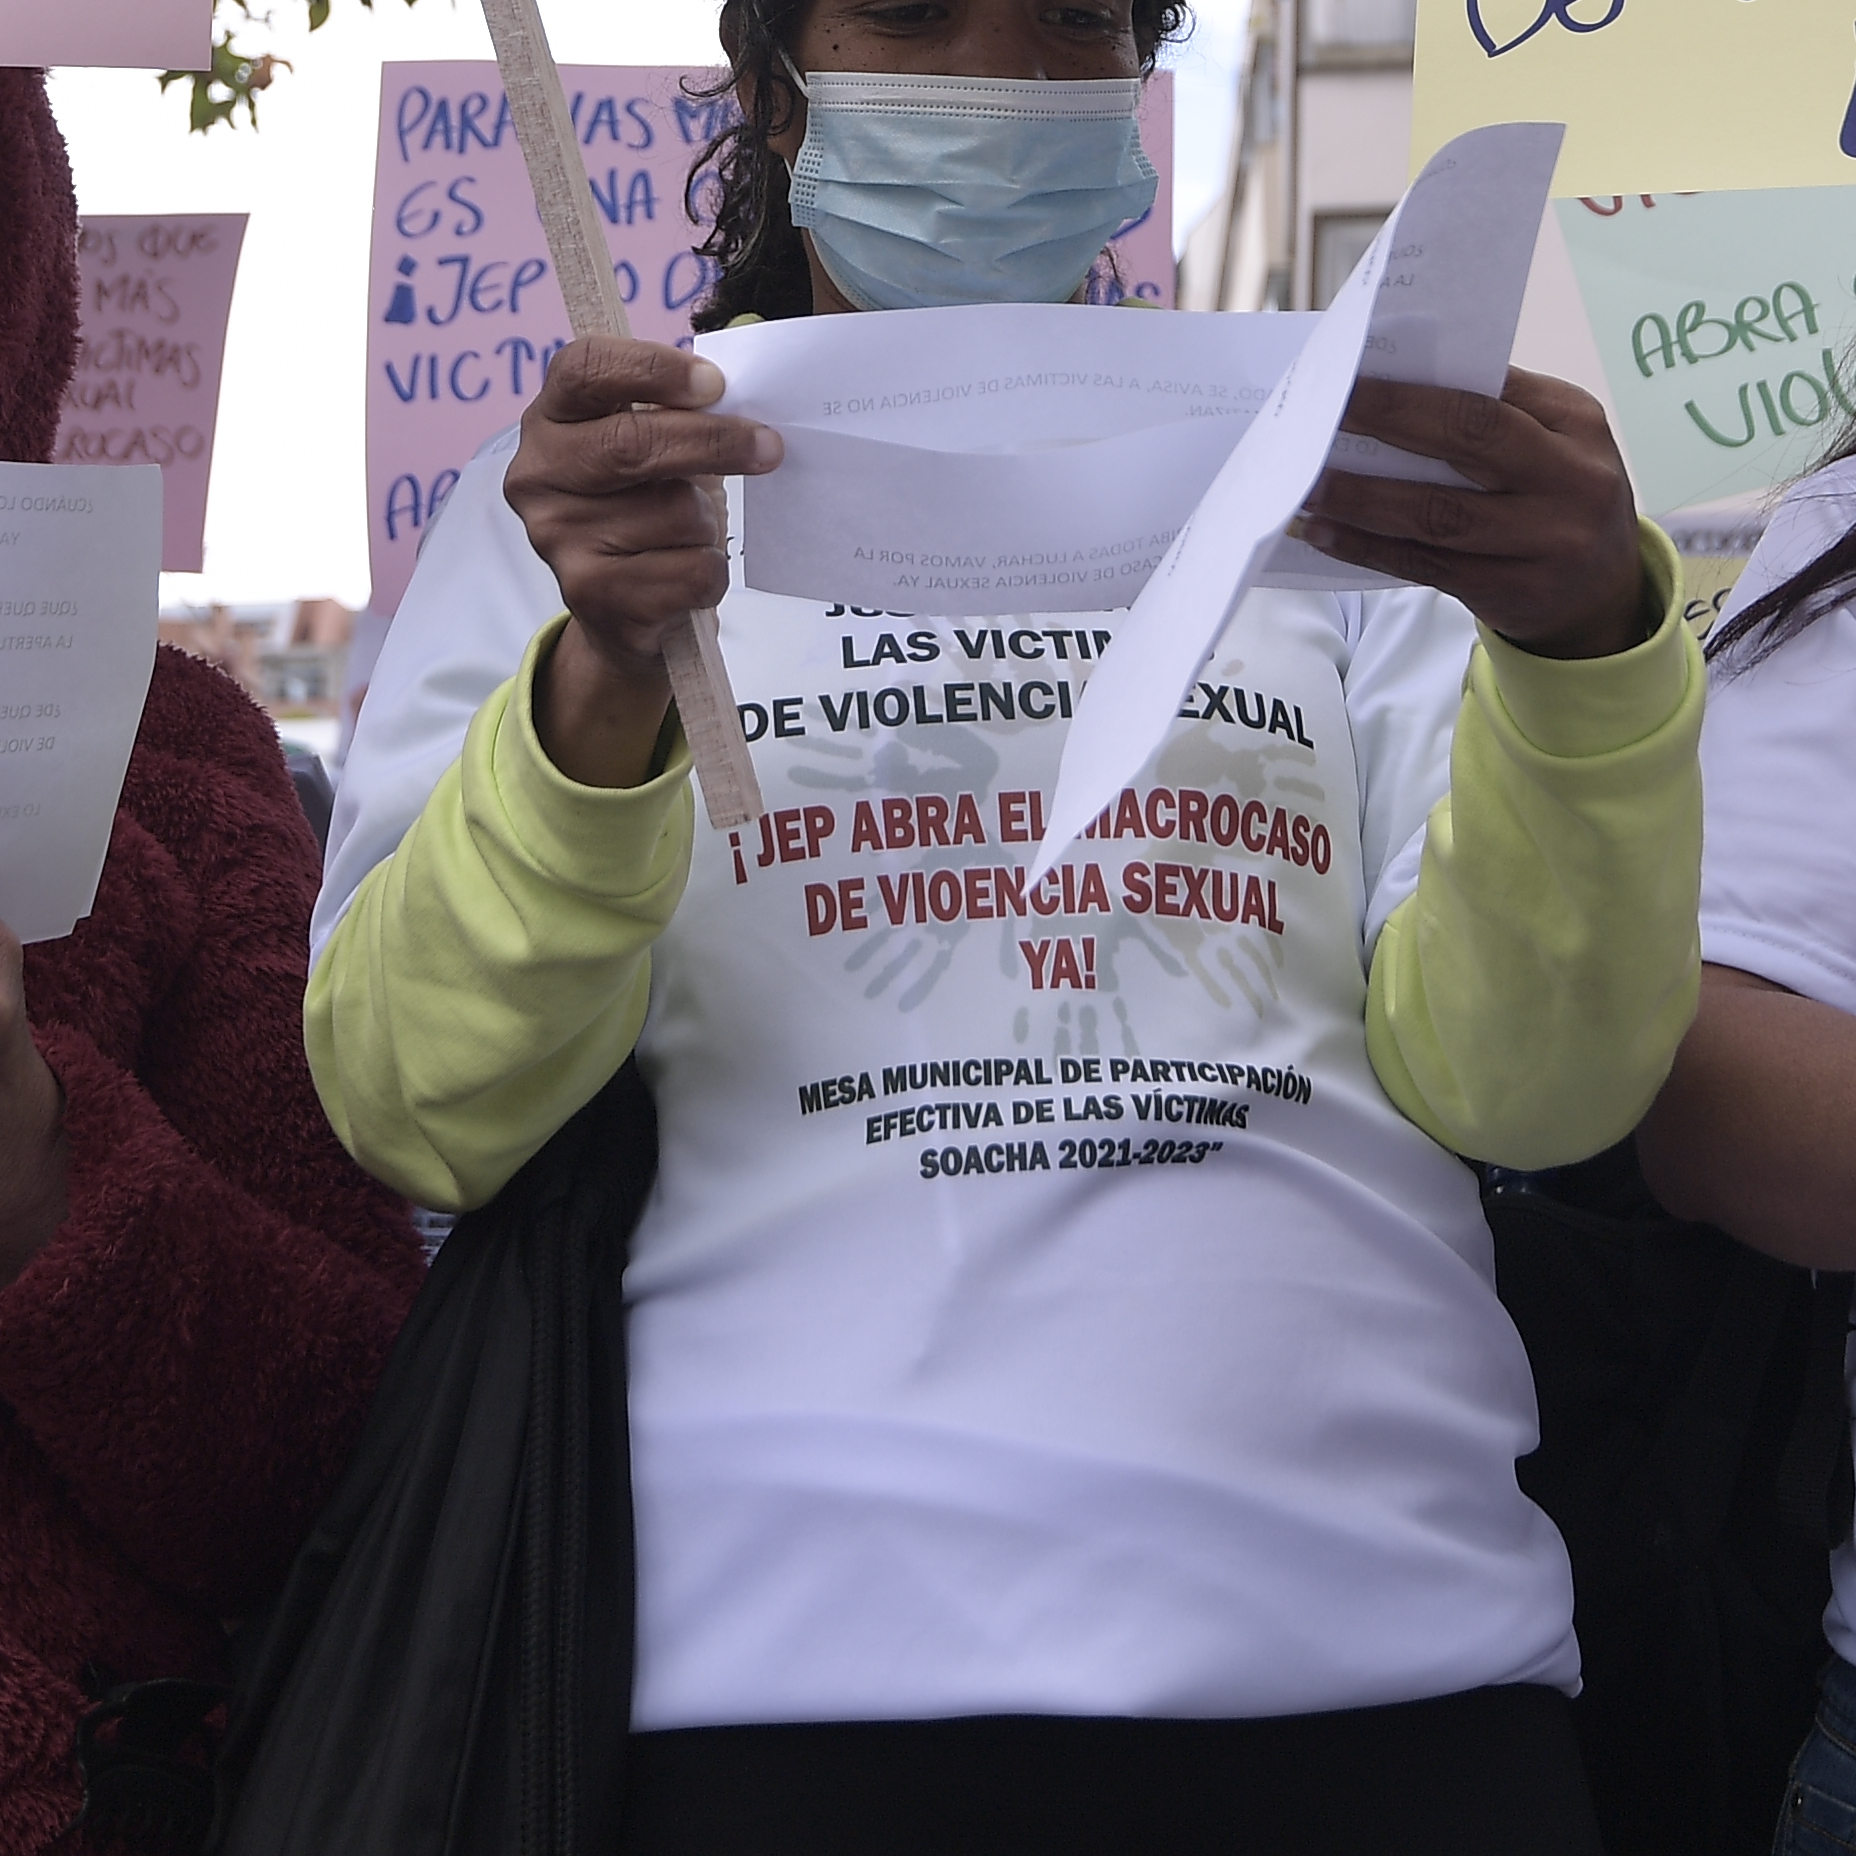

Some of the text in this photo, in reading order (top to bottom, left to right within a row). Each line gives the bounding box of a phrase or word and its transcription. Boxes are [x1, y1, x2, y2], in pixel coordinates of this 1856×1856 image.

[1630, 280, 1821, 379] ABRA
[841, 630, 941, 668] LAS
[740, 696, 806, 742] DE
[851, 792, 986, 854] ABRA
[998, 791, 1049, 842] EL
[805, 881, 868, 937] DE
[1121, 858, 1286, 936] SEXUAL
[1018, 938, 1097, 990] YA!
[798, 1056, 1313, 1116] MESA MUNICIPAL DE PARTICIPACIÓN
[865, 1087, 1250, 1145] EFECTIVA DE LAS VÍCTIMAS
[919, 1140, 1050, 1179] SOACHA
